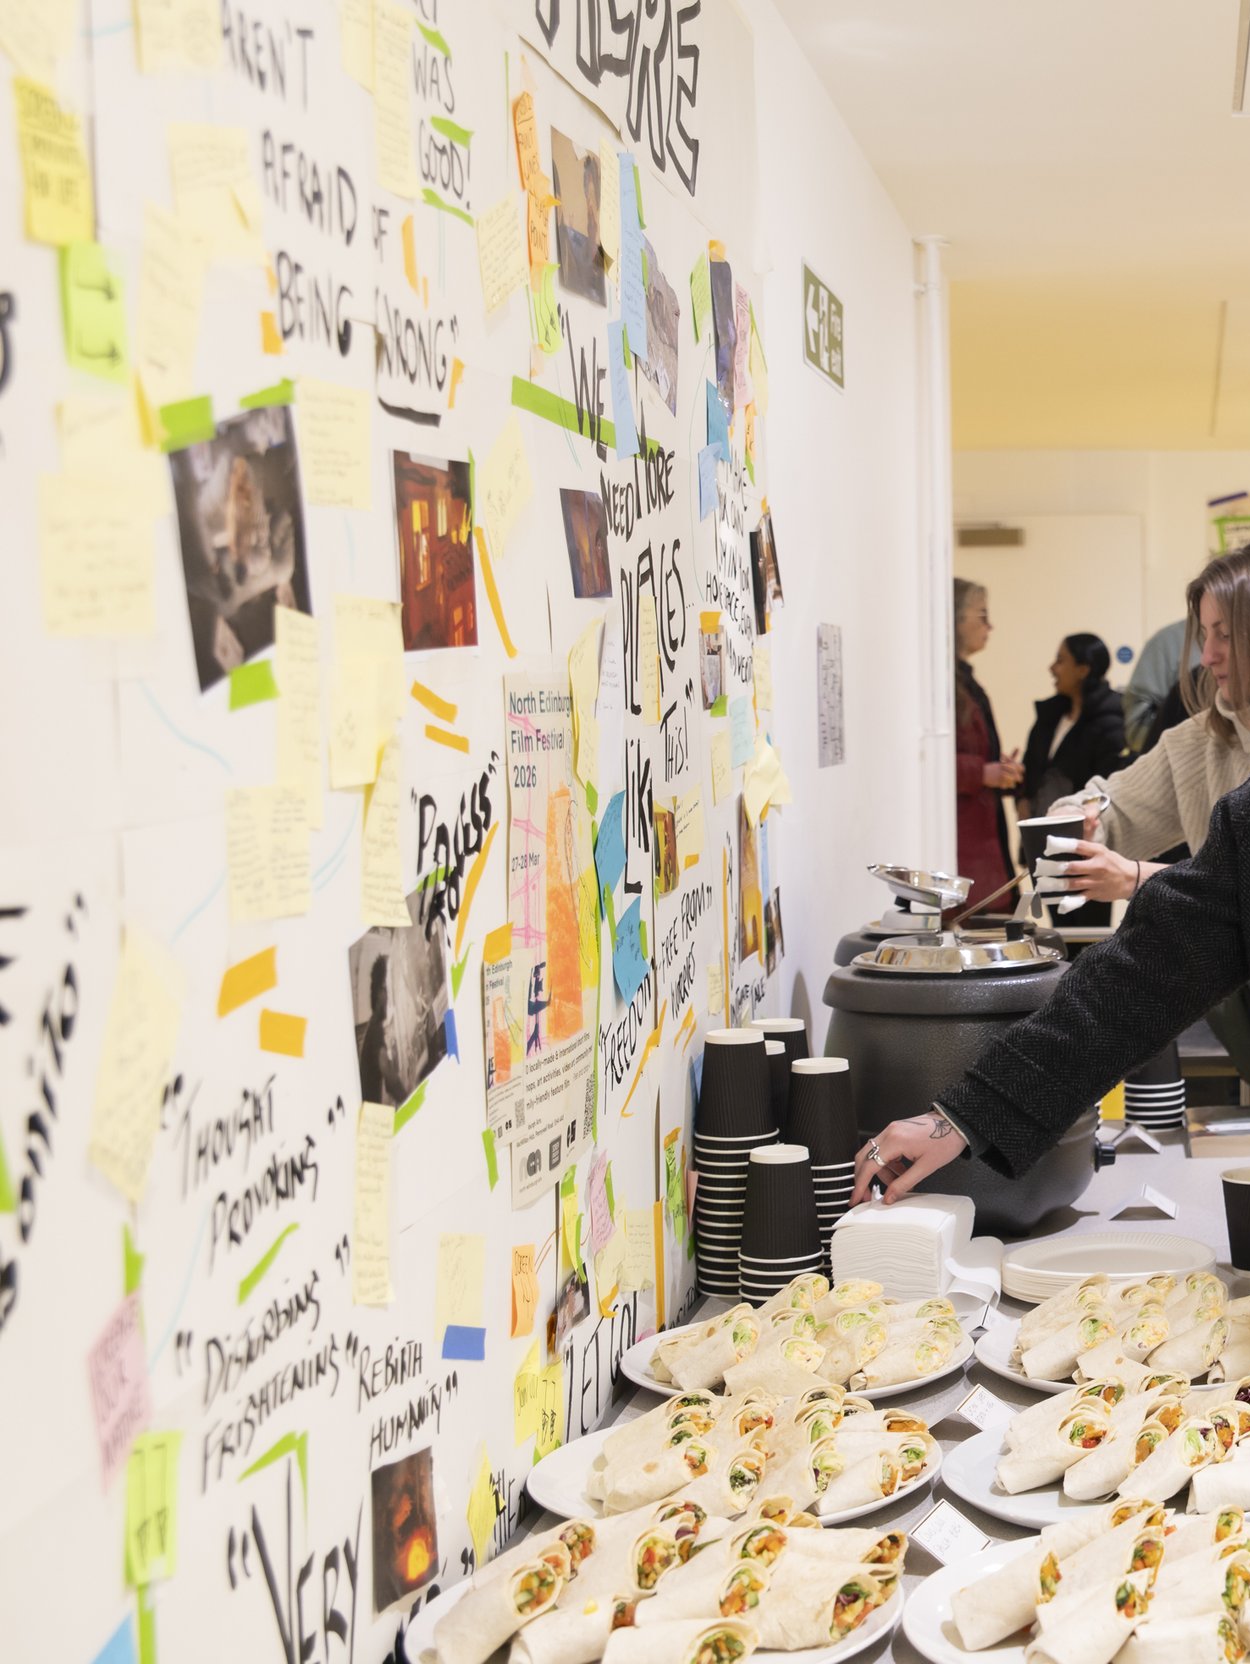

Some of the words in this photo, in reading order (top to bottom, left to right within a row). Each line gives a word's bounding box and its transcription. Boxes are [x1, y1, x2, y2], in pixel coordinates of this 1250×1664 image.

[412, 40, 455, 115] WAS
[262, 128, 358, 248] AFRAID
[276, 250, 353, 358] BEING
[600, 469, 635, 543] NEED
[508, 691, 537, 716] North
[538, 690, 574, 719] Edinburg
[511, 729, 534, 755] Film
[535, 727, 565, 752] Festival
[513, 764, 537, 789] 2026
[529, 852, 541, 867] Mar
